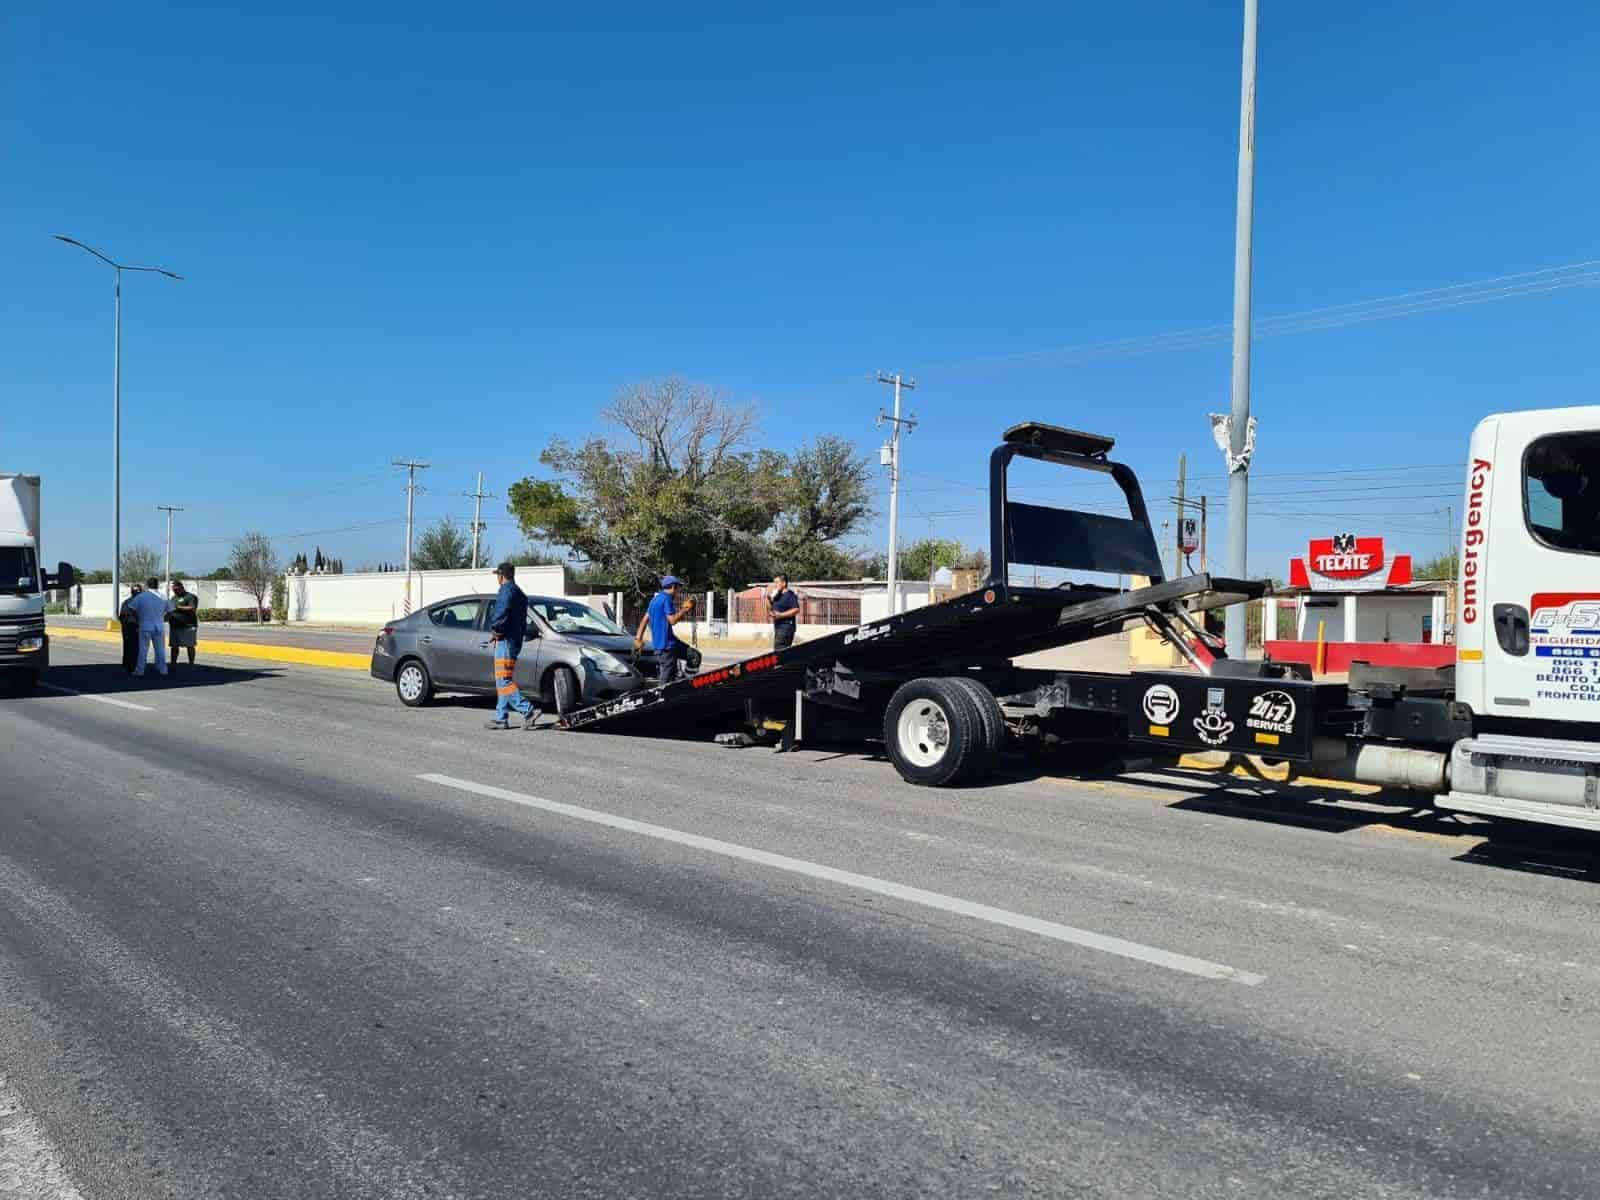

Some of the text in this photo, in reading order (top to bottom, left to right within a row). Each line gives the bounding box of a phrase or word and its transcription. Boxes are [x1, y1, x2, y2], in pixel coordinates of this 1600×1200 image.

[1463, 458, 1492, 624] emergency
[1316, 554, 1373, 571] TECATE
[1536, 673, 1588, 684] BENITO
[1250, 695, 1287, 721] 24/7
[1246, 718, 1293, 734] SERVICE
